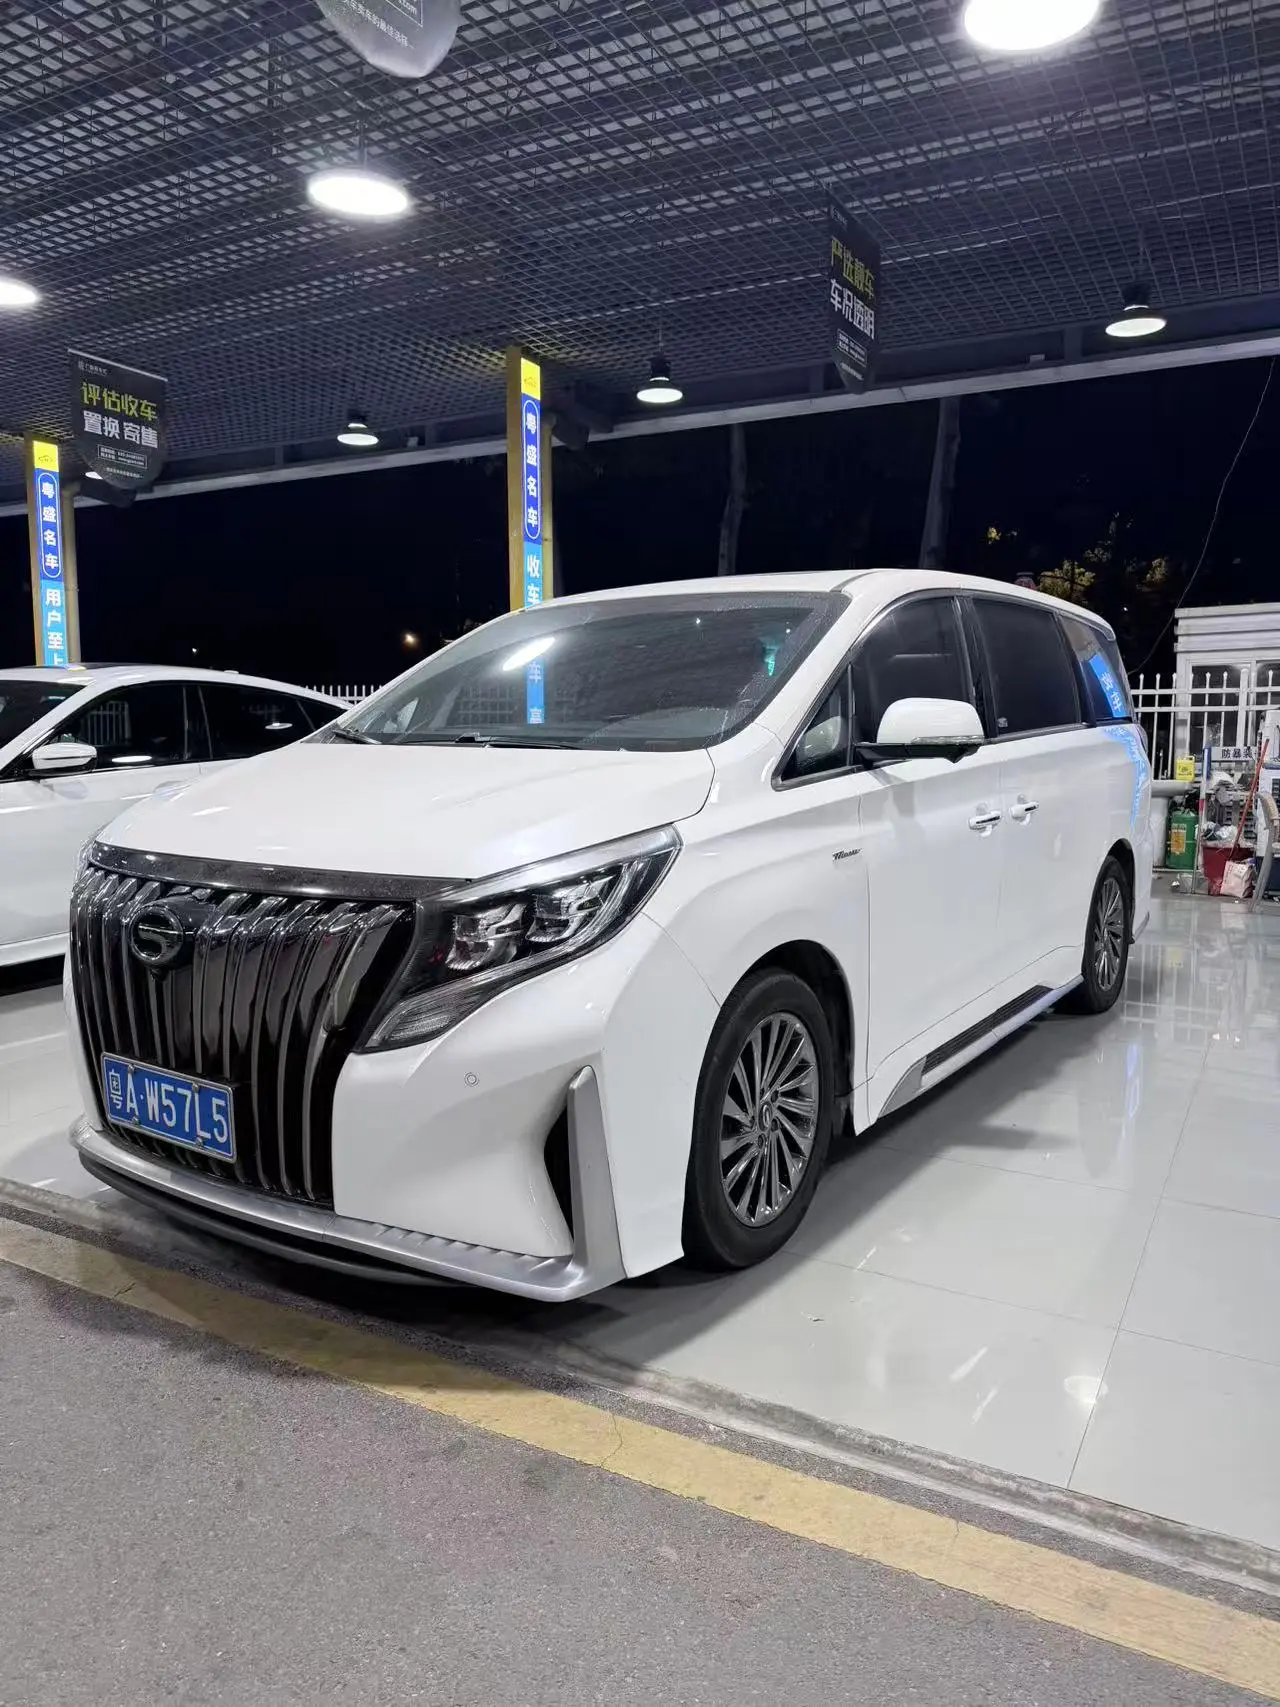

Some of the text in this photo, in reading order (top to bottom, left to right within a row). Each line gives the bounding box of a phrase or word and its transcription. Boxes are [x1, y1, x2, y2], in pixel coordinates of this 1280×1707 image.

[830, 278, 875, 340] 车况透明
[82, 381, 158, 420] 评估收车
[83, 410, 158, 448] 置换 寄售
[526, 412, 539, 527] 粤盛名车
[42, 482, 59, 569] 粤盛名车
[527, 554, 541, 606] 收车
[46, 588, 64, 666] 用户至上
[1221, 748, 1257, 759] 防暴装
